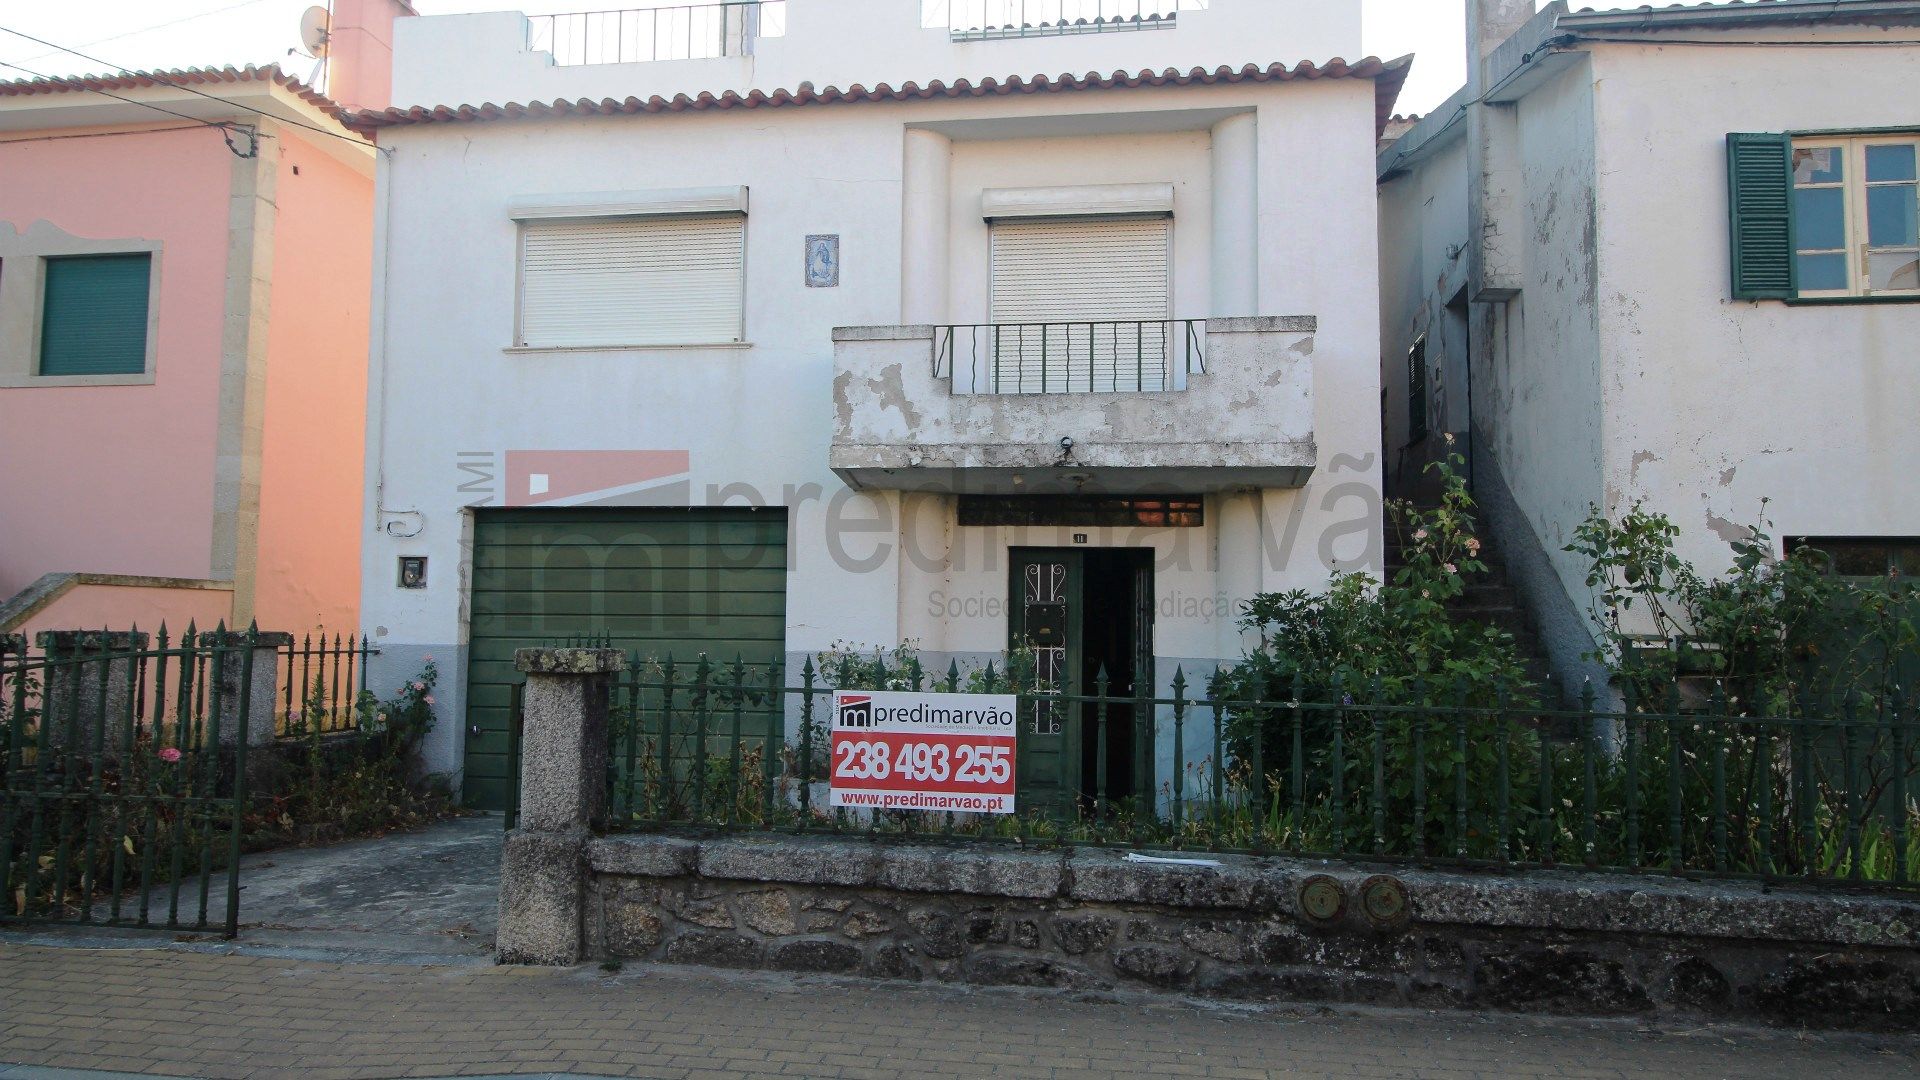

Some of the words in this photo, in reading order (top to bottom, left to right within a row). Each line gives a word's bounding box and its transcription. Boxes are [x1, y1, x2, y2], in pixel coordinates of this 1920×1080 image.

[874, 703, 1013, 727] predimarvão
[835, 740, 890, 780] 238
[894, 743, 950, 782] 493
[954, 744, 1011, 784] 255
[841, 792, 1003, 813] www.predimarvao.pt
